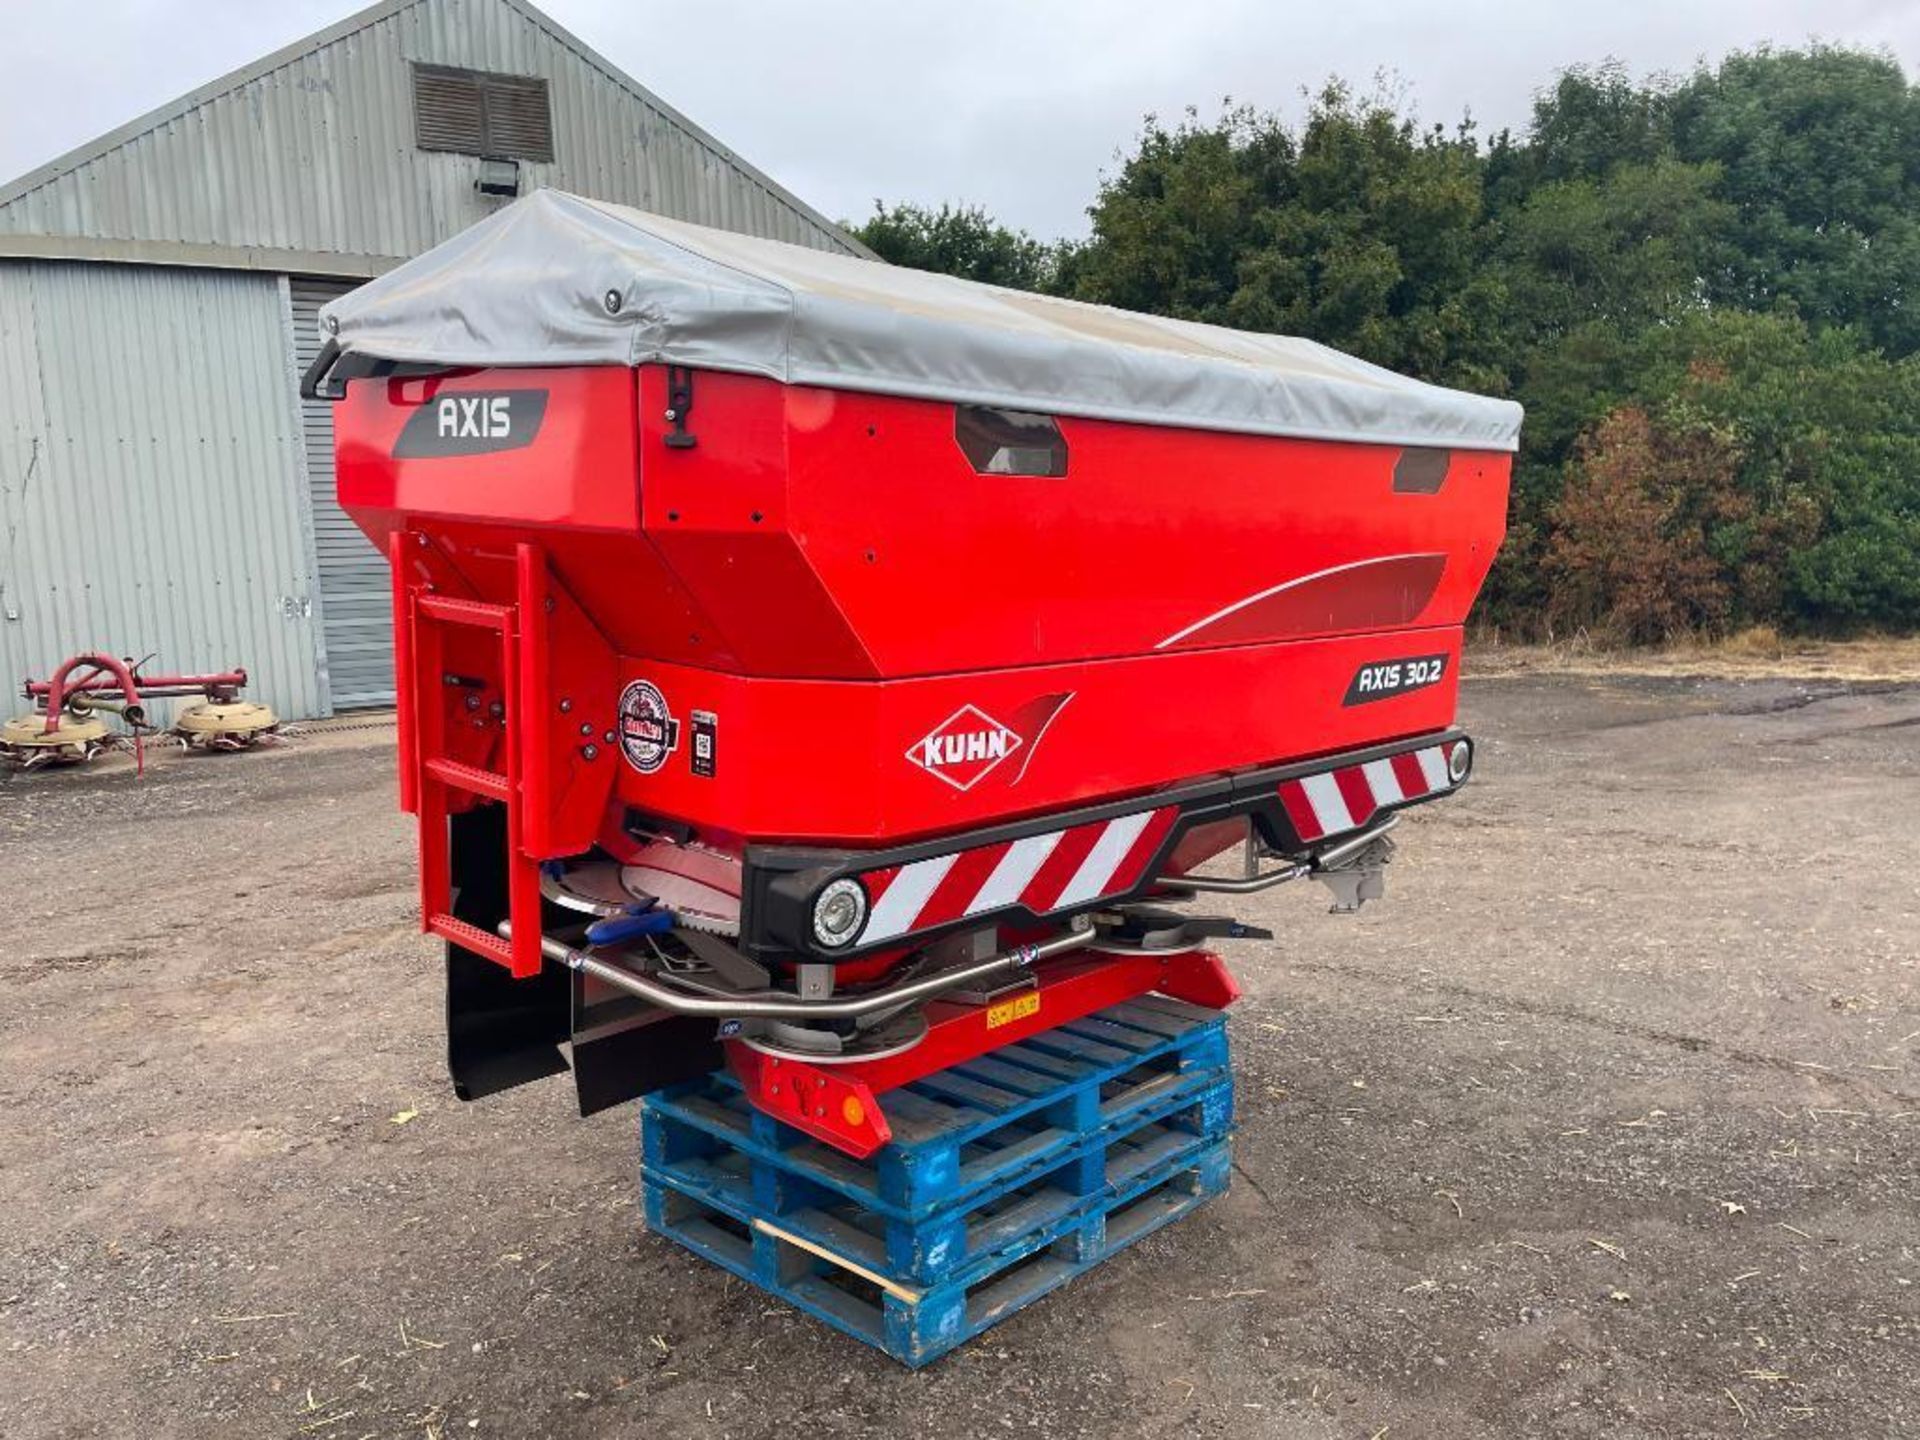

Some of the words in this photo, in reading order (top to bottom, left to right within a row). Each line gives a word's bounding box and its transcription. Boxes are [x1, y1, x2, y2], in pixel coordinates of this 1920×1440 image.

[438, 397, 511, 438] AXIS
[1359, 664, 1401, 692] AXIS
[1404, 659, 1442, 686] 30.2
[924, 729, 1008, 768] KUHN
